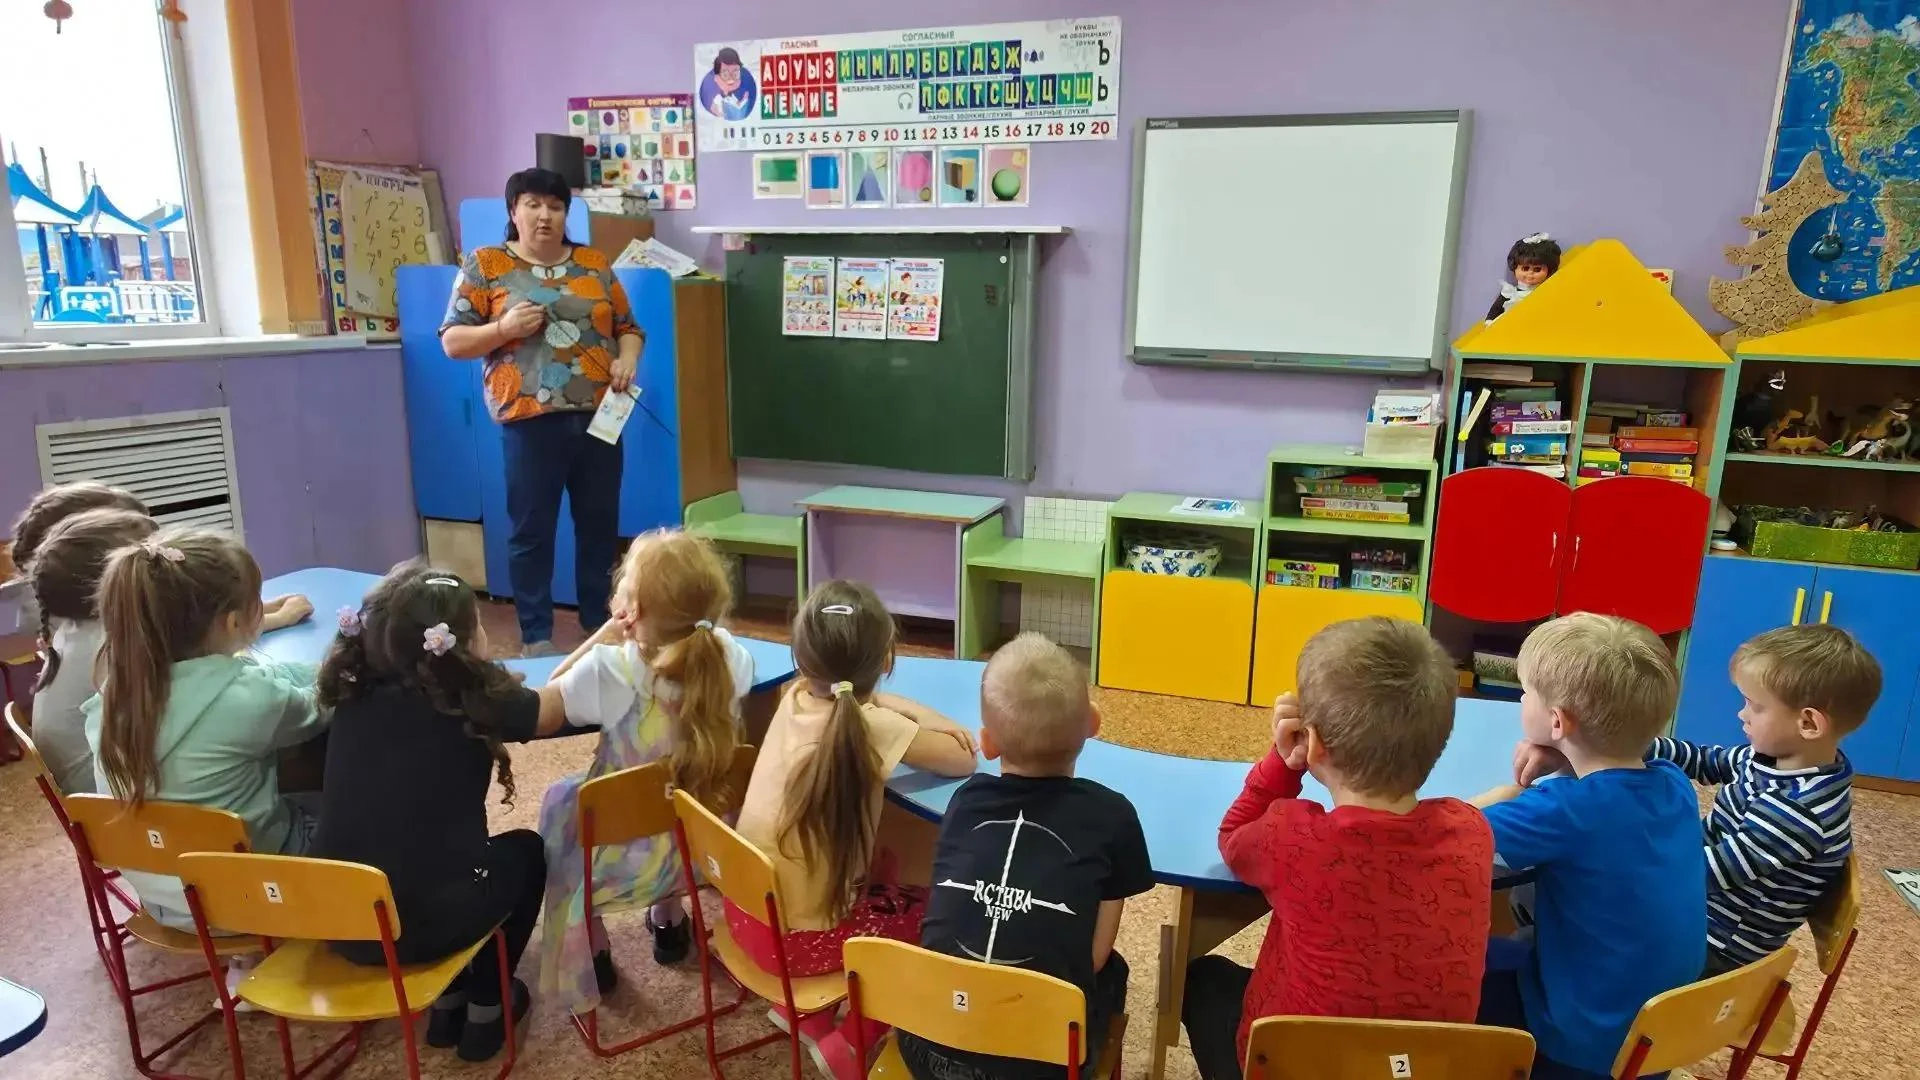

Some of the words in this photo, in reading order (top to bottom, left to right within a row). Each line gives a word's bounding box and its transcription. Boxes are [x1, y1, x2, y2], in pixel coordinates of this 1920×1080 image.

[902, 31, 955, 41] СОГЛАСНЫЕ
[780, 40, 818, 49] ГЛАСНЫЕ
[763, 61, 773, 82] А
[778, 59, 788, 81] О
[793, 59, 803, 80] У
[807, 58, 820, 80] Ы
[825, 57, 835, 79] Э
[842, 84, 881, 93] НЕПАРНЫЕ
[882, 82, 915, 91] ЗВОНКИЕ
[1025, 109, 1062, 117] НЕПАРНЫЕ
[763, 133, 771, 145] 0
[775, 132, 781, 144] 1
[786, 132, 794, 144] 2
[798, 131, 805, 143] 3
[810, 131, 818, 143] 4
[822, 131, 830, 143] 5
[834, 131, 842, 142] 6
[847, 130, 854, 142] 7
[858, 130, 866, 142] 8
[871, 129, 879, 141] 9
[884, 129, 898, 141] 10
[904, 128, 916, 140] 11
[922, 127, 937, 140] 12
[942, 127, 958, 139] 13
[963, 126, 979, 139] 14
[984, 125, 1000, 138] 15
[1005, 124, 1021, 137] 16
[1026, 123, 1042, 136] 17
[1047, 123, 1063, 136] 18
[1069, 122, 1086, 135] 19
[1091, 121, 1110, 135] 20
[388, 200, 398, 222] 2
[414, 206, 424, 227] 3
[152, 833, 160, 844] 2
[268, 886, 277, 897] 2
[984, 905, 1013, 922] NEW
[957, 994, 966, 1006] 2
[1395, 1060, 1406, 1073] 2
